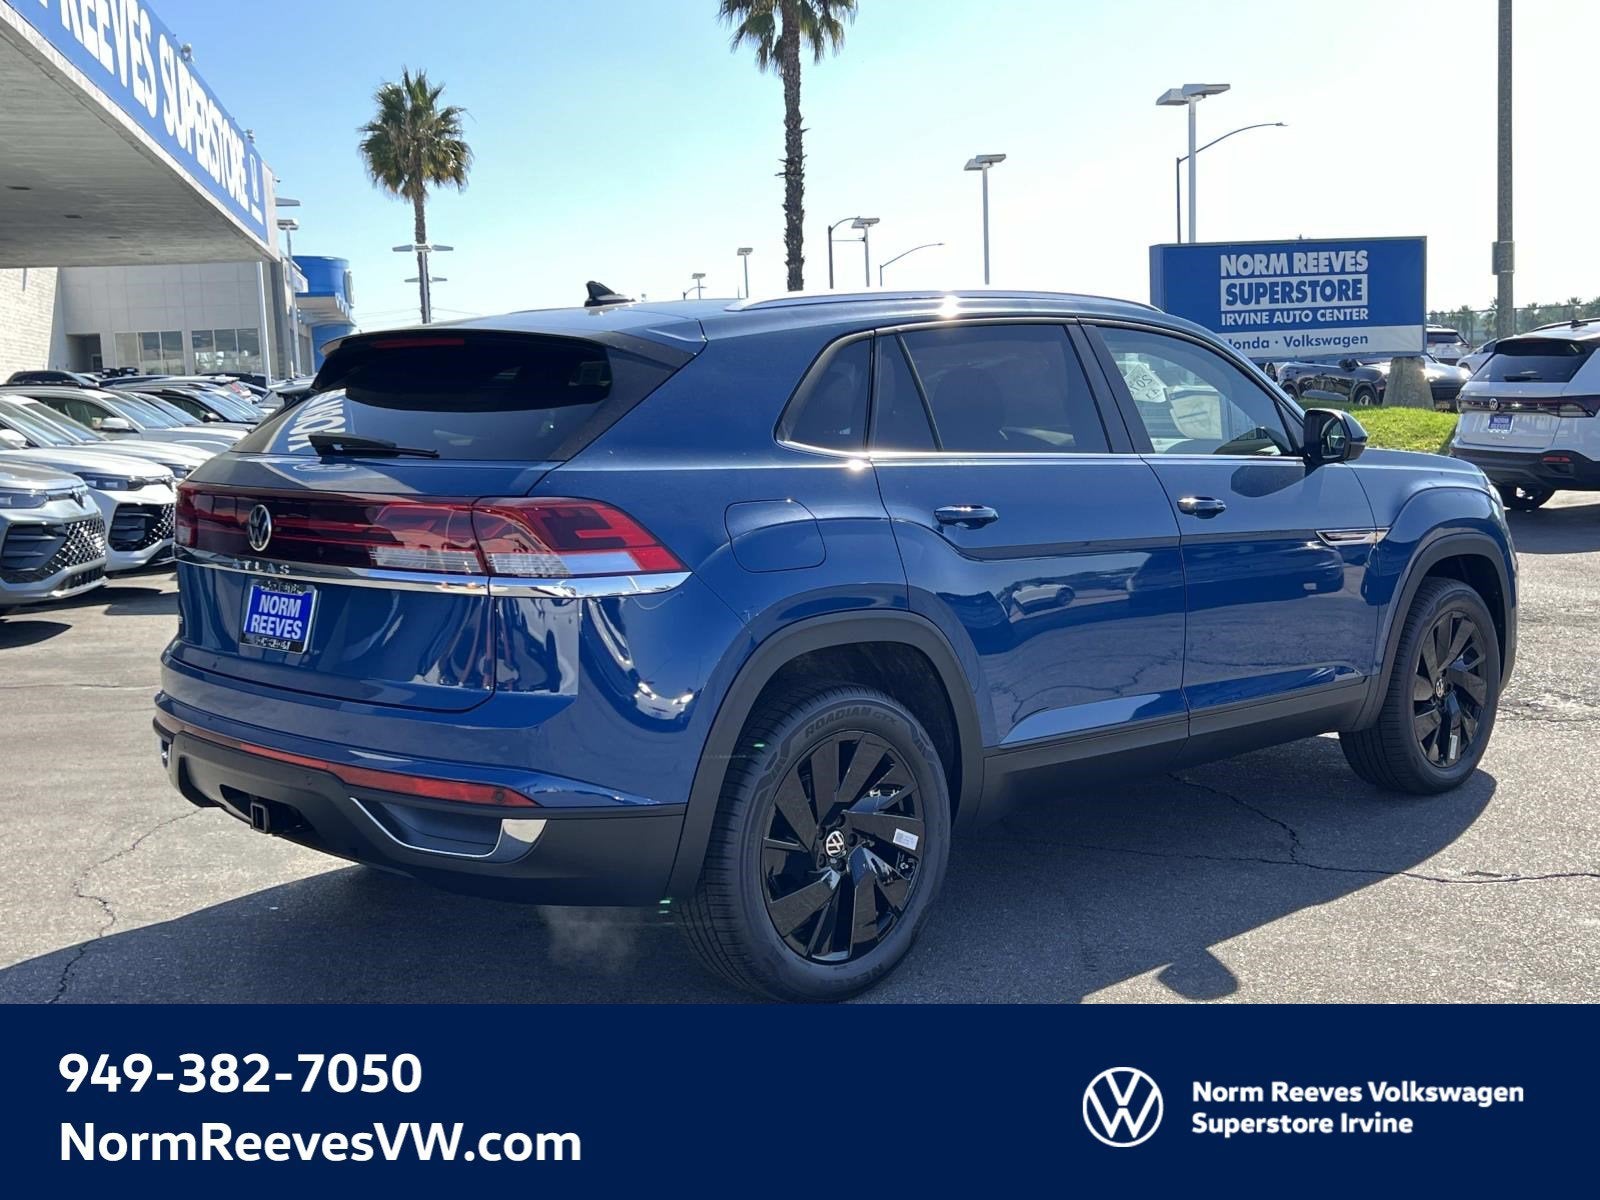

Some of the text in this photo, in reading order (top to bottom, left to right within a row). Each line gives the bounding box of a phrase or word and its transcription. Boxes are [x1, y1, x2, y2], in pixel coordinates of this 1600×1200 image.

[60, 0, 249, 212] EVES SUPERSTORE
[1220, 250, 1368, 277] NORM REEVES
[1225, 278, 1362, 306] SUPERSTORE
[1221, 307, 1368, 326] IRVINE AUTO CENTER
[1283, 334, 1368, 348] Volkswagen
[232, 558, 290, 576] ATLAS
[259, 594, 302, 618] NORM
[250, 614, 303, 640] REEVES
[805, 706, 873, 738] ROADIAN
